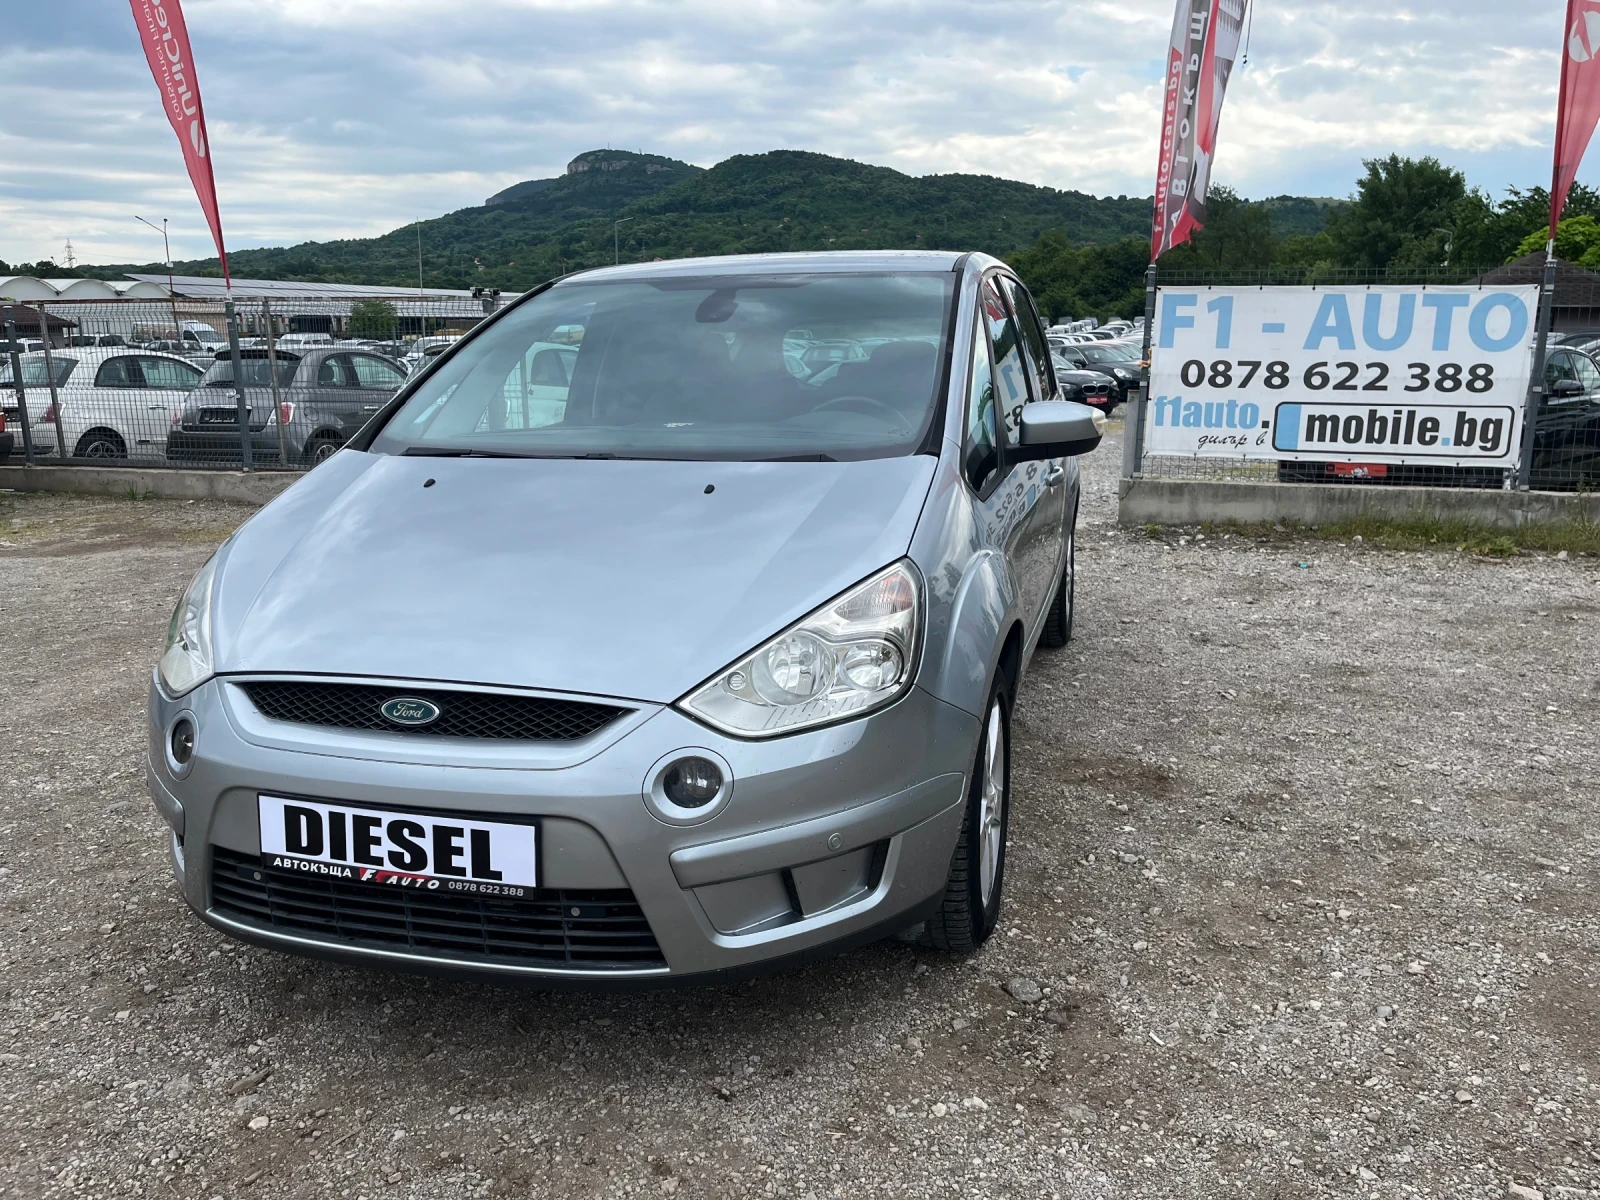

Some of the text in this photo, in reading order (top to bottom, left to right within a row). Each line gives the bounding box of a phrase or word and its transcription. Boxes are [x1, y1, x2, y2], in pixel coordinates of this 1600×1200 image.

[1159, 292, 1529, 352] F1 - AUTO
[1180, 359, 1495, 393] 0878 622 388
[1305, 408, 1504, 452] mobile.bg
[392, 702, 425, 719] Ford
[284, 804, 503, 881] DIESEL
[273, 857, 352, 878] АВТОКЪЩА
[386, 875, 440, 889] AUTO
[448, 881, 477, 892] 0878
[479, 884, 500, 894] 622
[502, 886, 524, 896] 388
